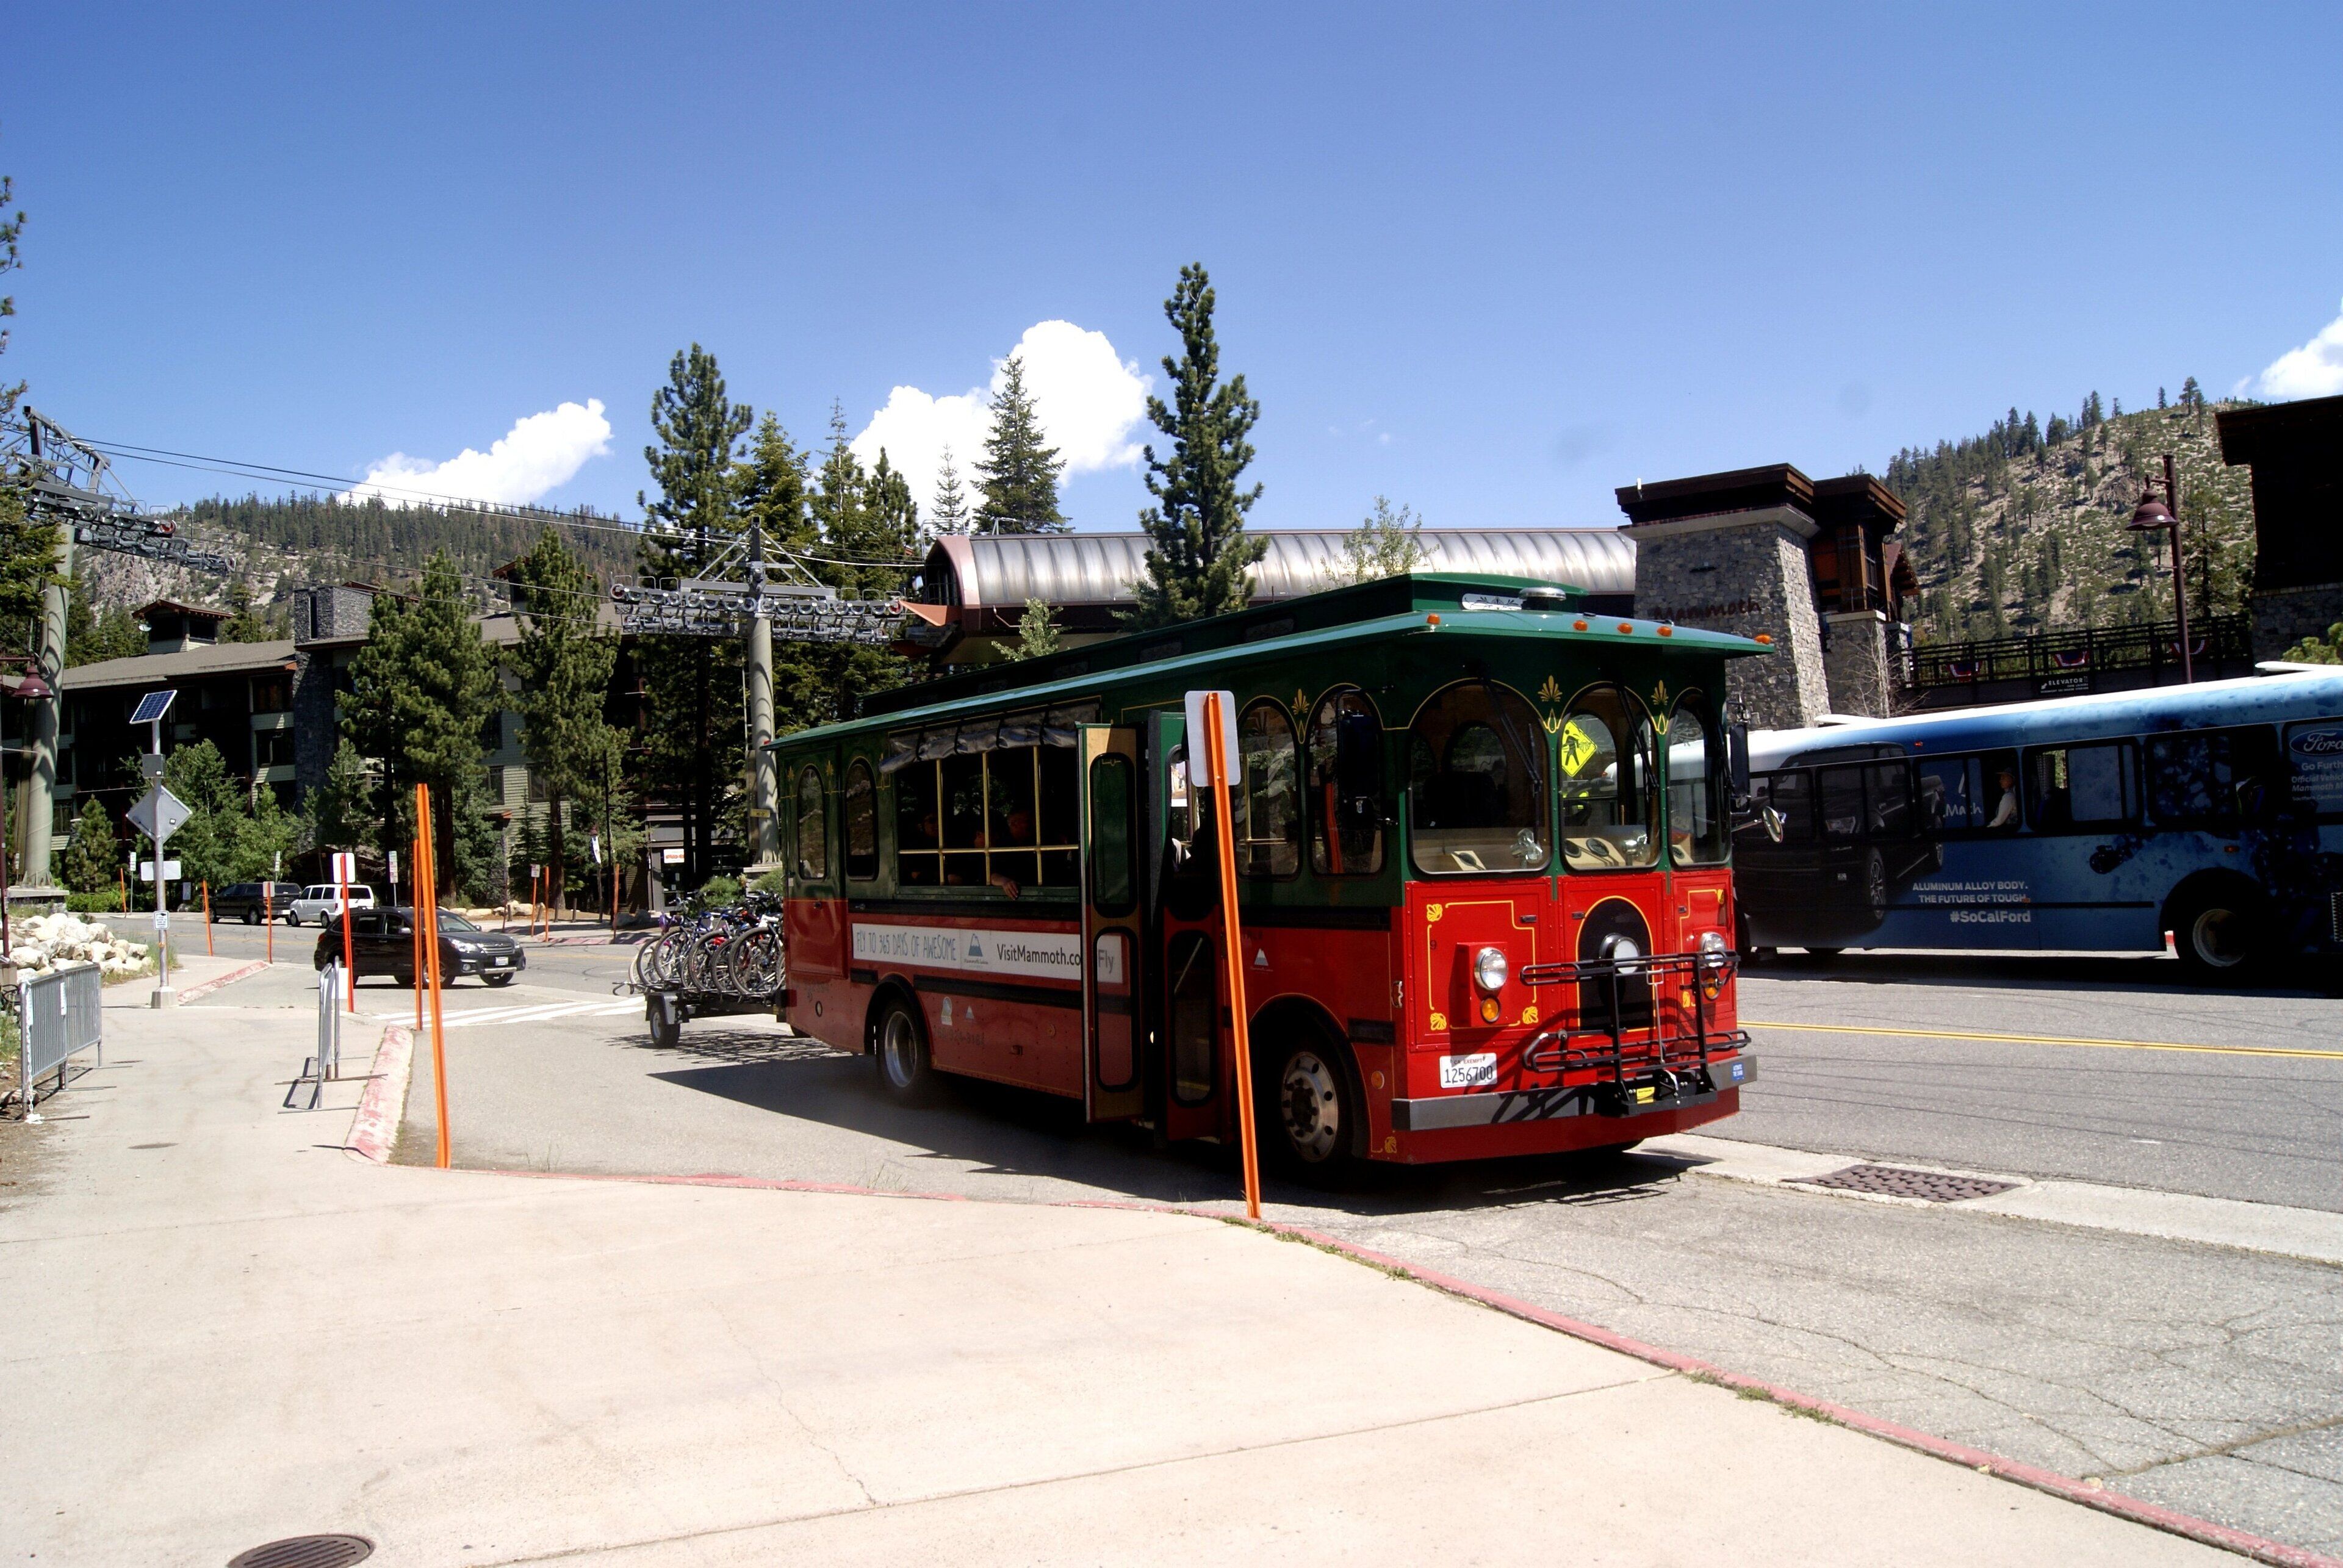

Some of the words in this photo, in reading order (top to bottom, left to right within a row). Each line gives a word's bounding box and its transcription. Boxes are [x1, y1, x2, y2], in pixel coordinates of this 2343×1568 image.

[1912, 882, 1963, 891] ALUMINUM
[1965, 882, 1995, 890] ALLOY
[1997, 881, 2028, 890] BODY.
[1919, 894, 1937, 903] THE
[1938, 894, 1976, 903] FUTURE
[1950, 910, 2031, 922] #SoCalFord
[857, 930, 865, 952] FLY
[869, 932, 876, 953] TO
[879, 934, 890, 955] 365
[893, 932, 908, 956] DAYS
[911, 935, 920, 957] OF
[923, 934, 956, 961] AWESOME
[1098, 949, 1114, 974] Fly
[1445, 1065, 1494, 1084] 1256700
